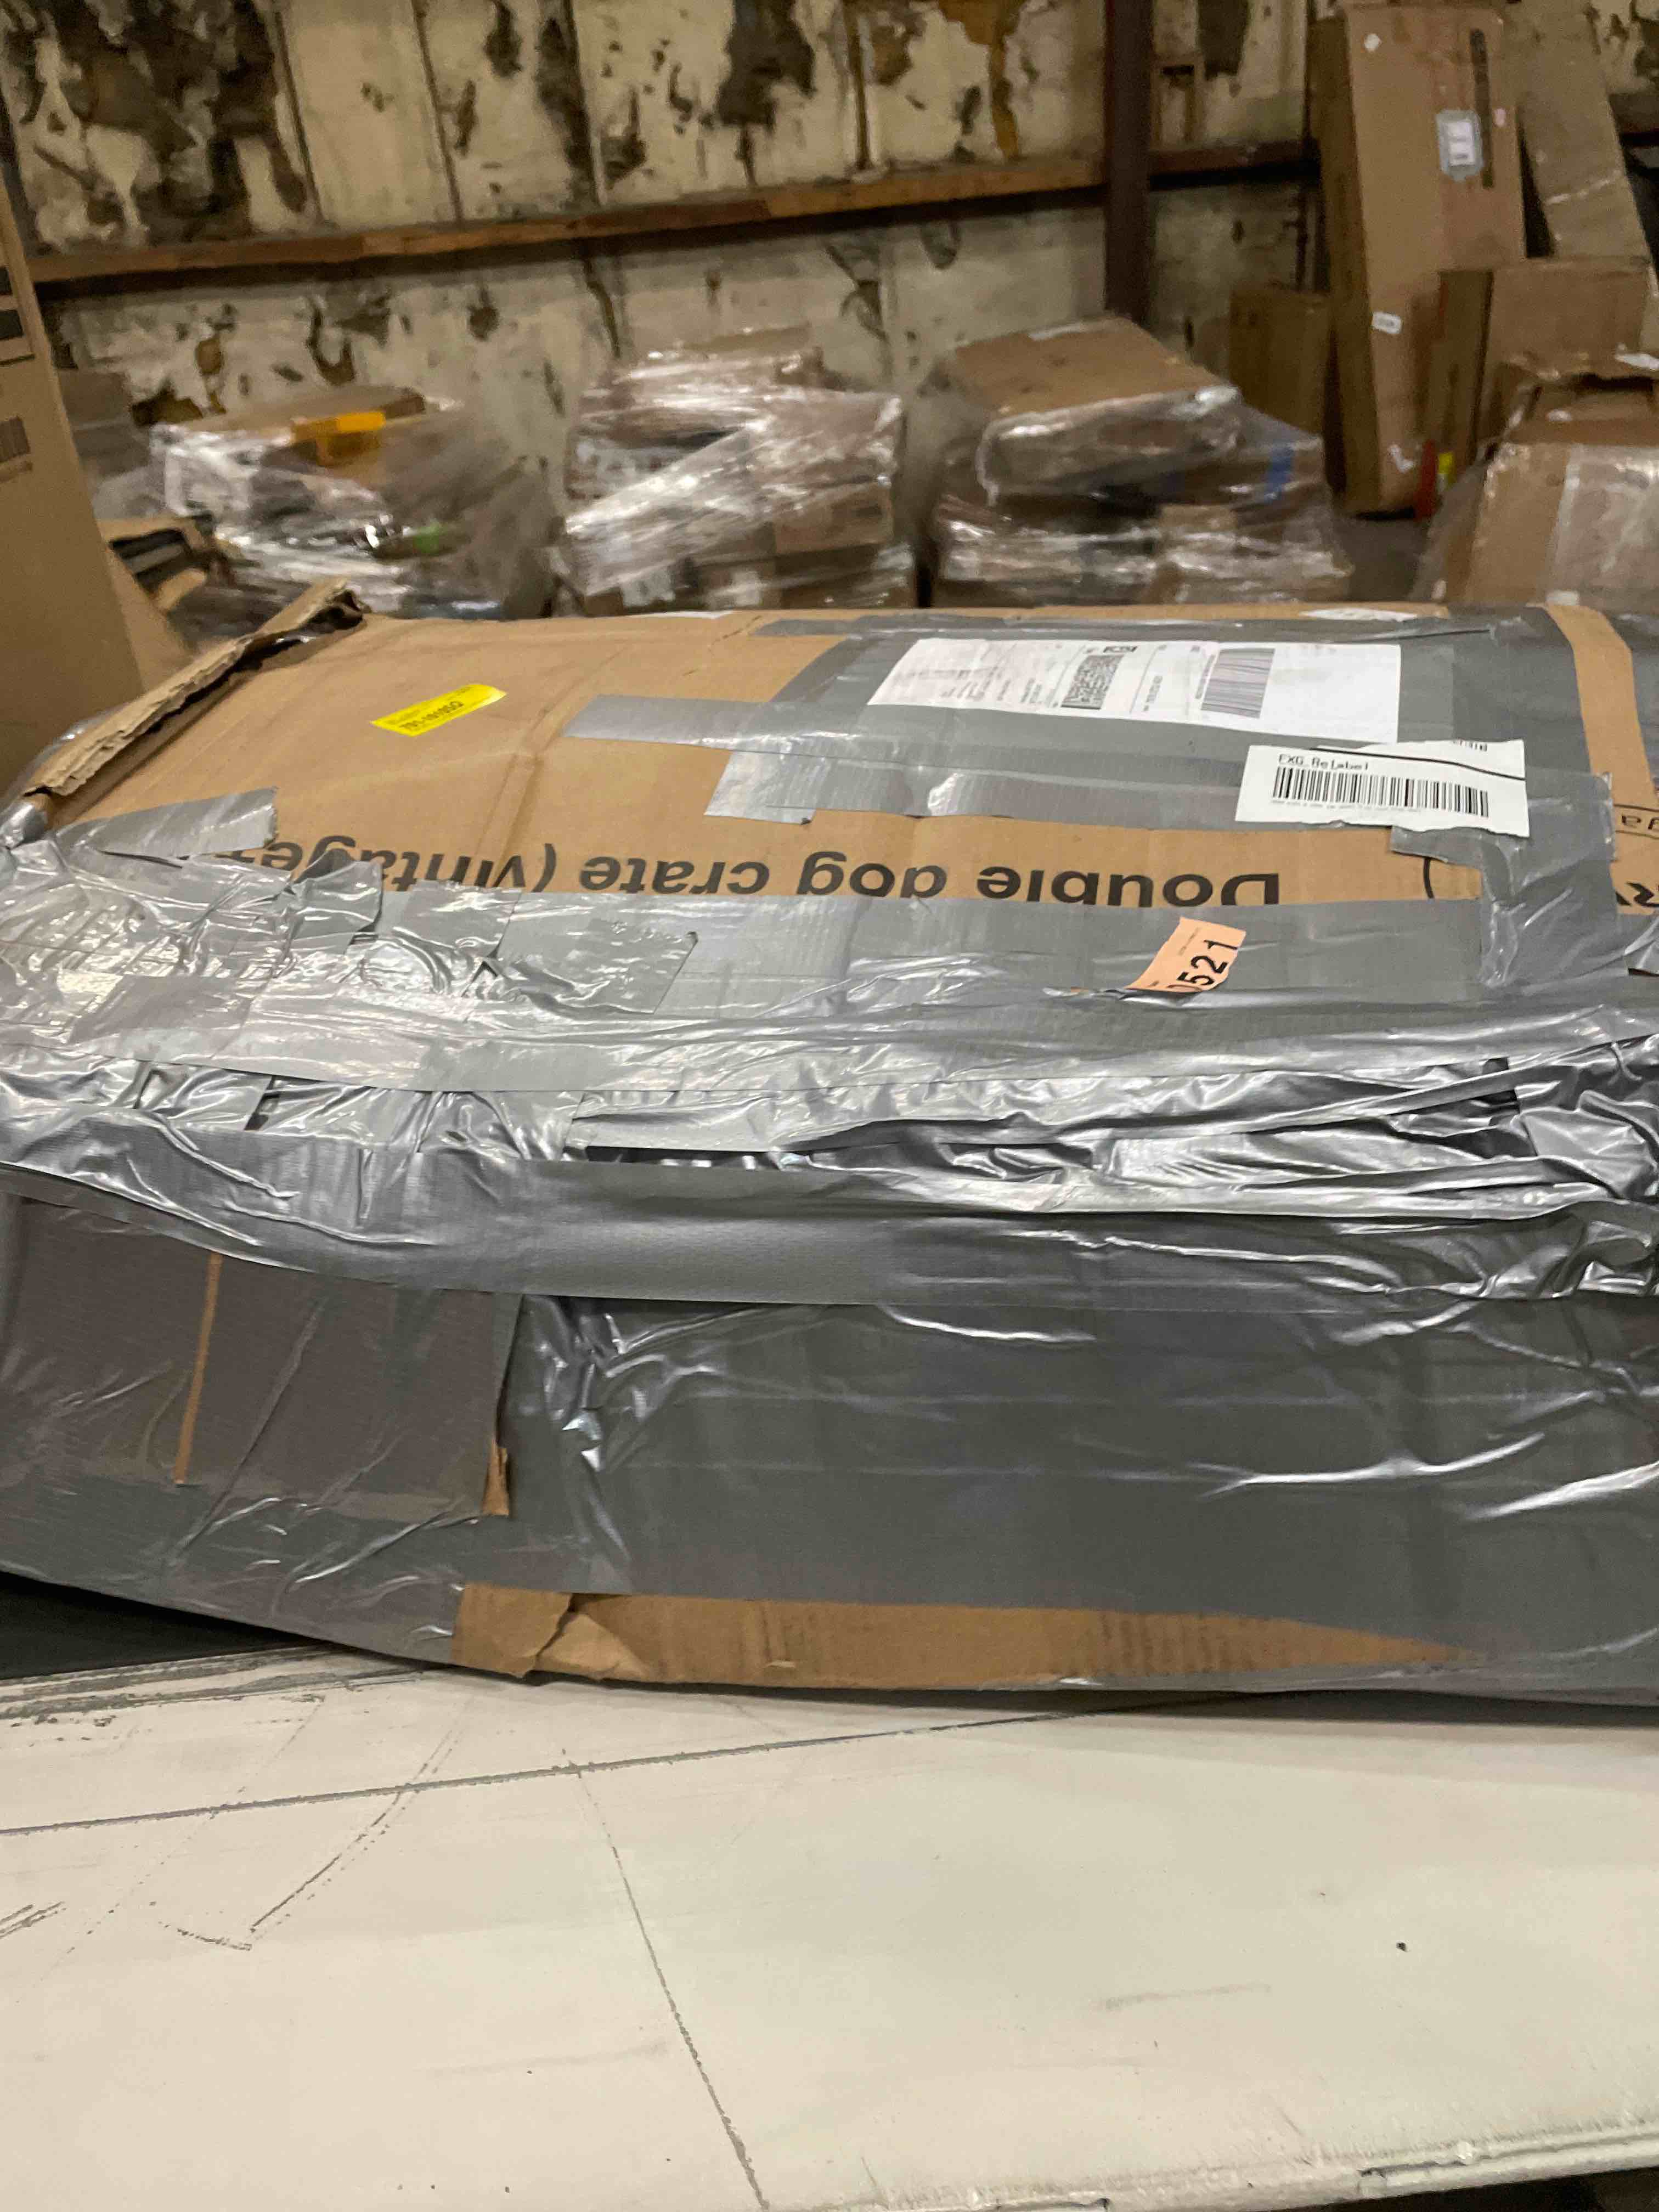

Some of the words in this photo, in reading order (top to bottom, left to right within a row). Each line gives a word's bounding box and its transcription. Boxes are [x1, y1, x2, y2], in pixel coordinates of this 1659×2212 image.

[579, 856, 770, 895] crate
[797, 851, 947, 899] dog
[977, 866, 1279, 908] Double
